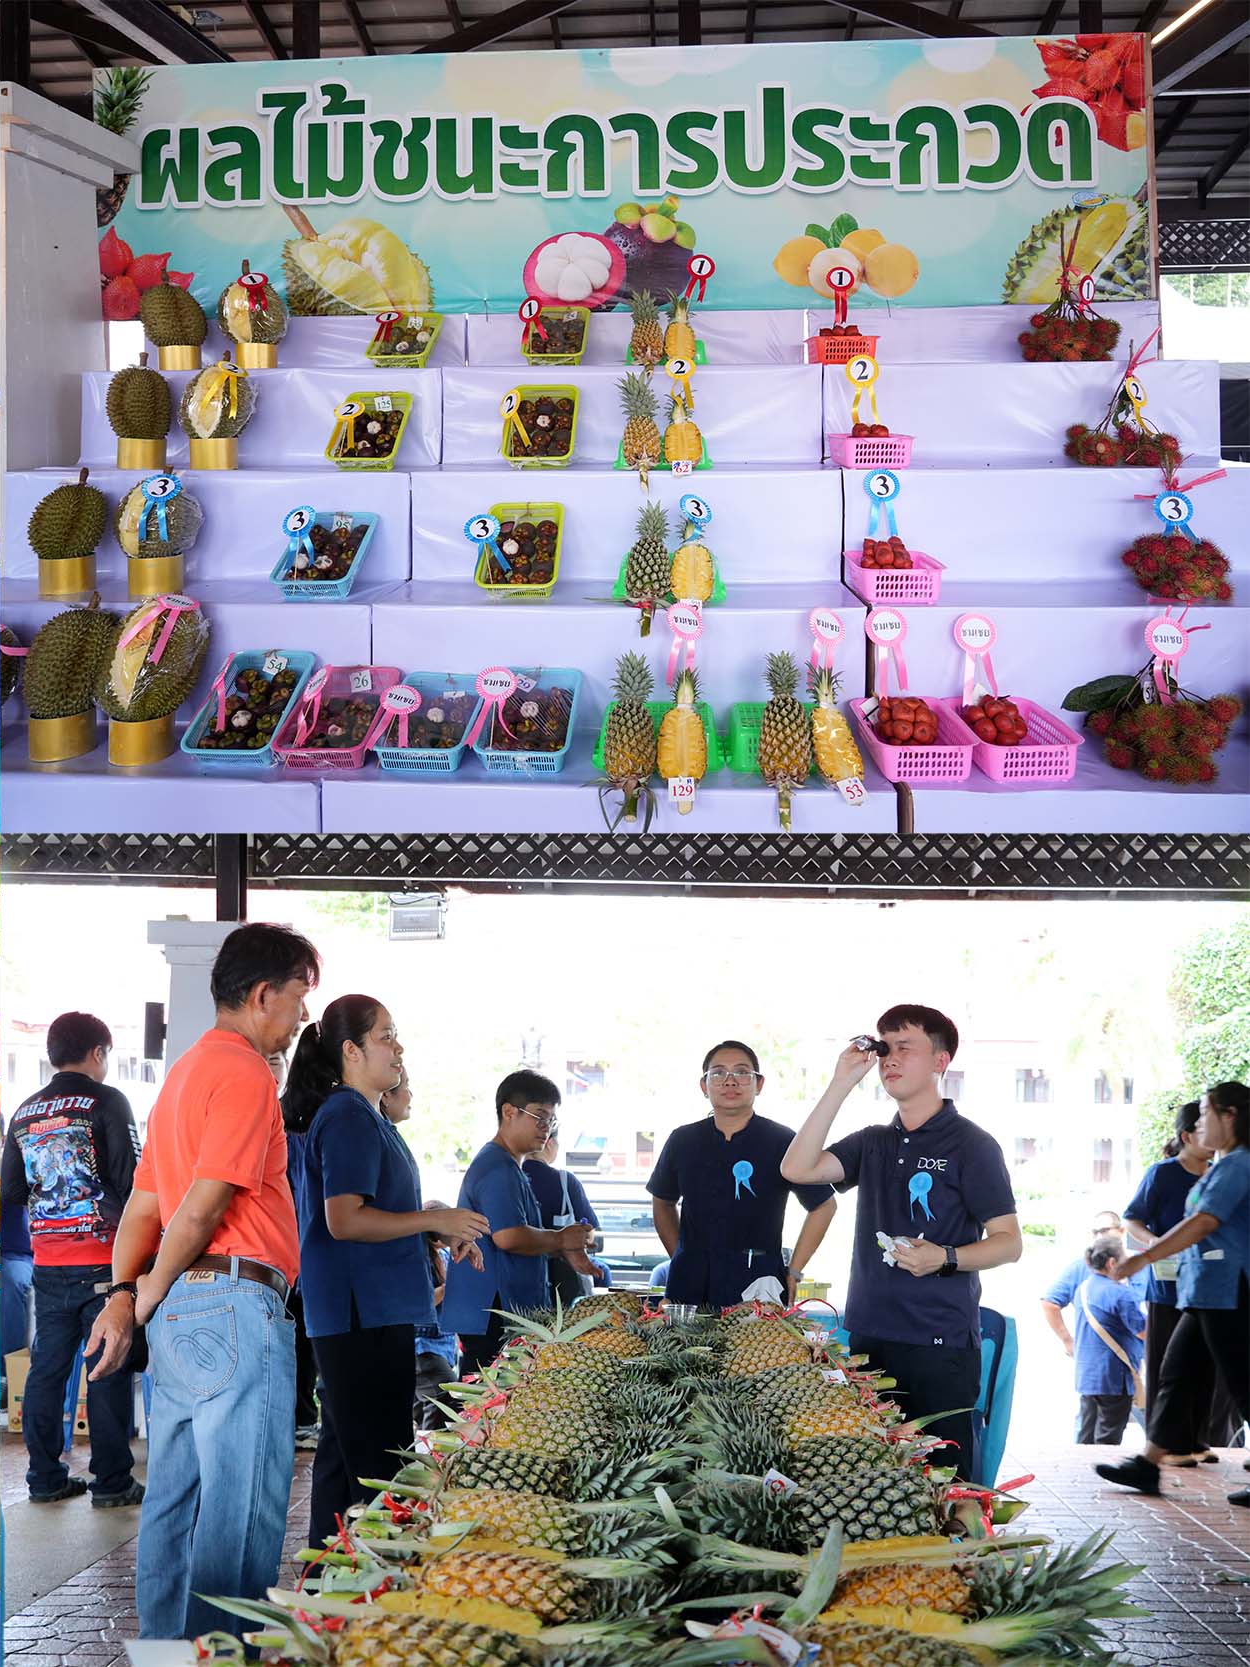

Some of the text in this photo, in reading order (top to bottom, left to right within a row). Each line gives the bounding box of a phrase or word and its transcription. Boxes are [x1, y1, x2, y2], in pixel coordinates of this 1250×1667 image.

[141, 83, 1092, 202] ผลไม้ชนะการประกวด
[697, 260, 705, 274] 1
[248, 275, 257, 284] 1
[837, 271, 843, 286] 1
[673, 360, 686, 374] 2
[855, 360, 868, 380] 2
[1132, 382, 1142, 400] 2
[342, 404, 355, 416] 2
[507, 395, 515, 412] 2
[151, 478, 170, 496] 3
[876, 475, 889, 496] 3
[690, 499, 703, 518] 3
[1166, 498, 1182, 520] 3
[292, 511, 305, 531] 3
[475, 519, 490, 538] 3
[872, 621, 901, 631] ชมเชย
[961, 628, 990, 638] ชมเชย
[1153, 634, 1183, 645] ชมเชย
[354, 676, 369, 688] 26
[483, 678, 511, 688] ชมเชย
[388, 692, 415, 705] ชมเชย
[673, 785, 693, 797] 129
[846, 784, 863, 800] 53
